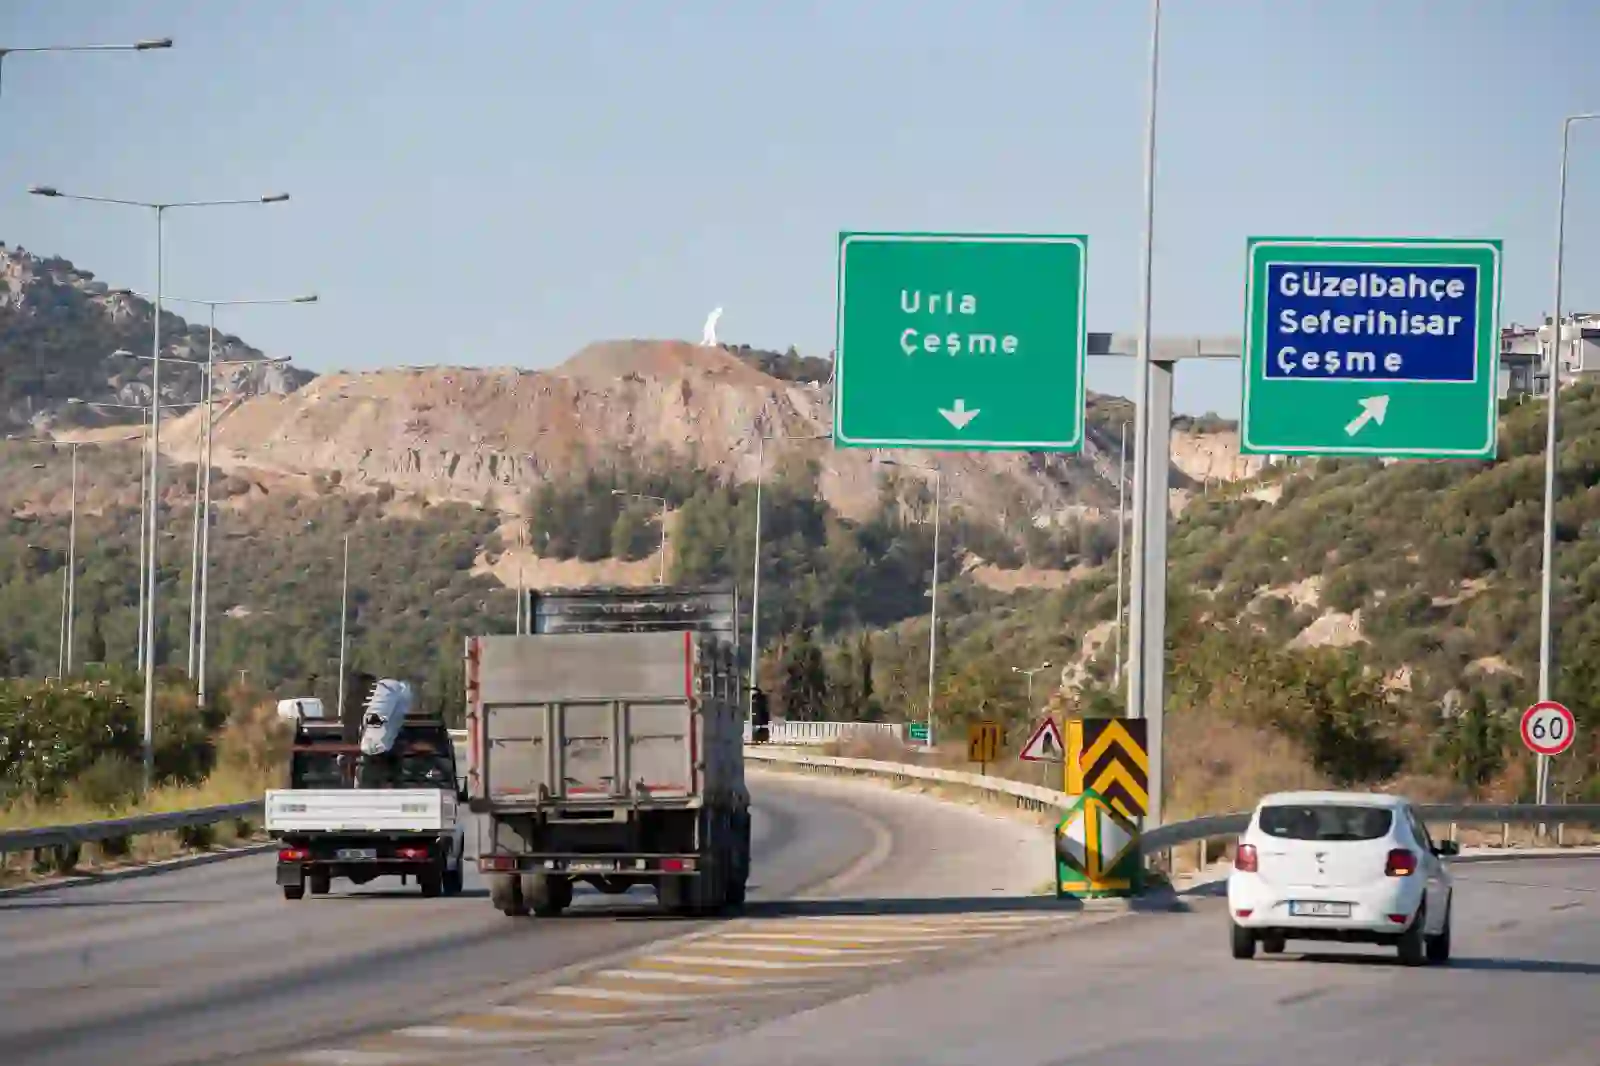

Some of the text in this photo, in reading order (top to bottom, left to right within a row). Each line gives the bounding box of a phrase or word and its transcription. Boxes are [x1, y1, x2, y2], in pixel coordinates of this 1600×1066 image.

[1279, 271, 1465, 301] Güzelbahçe
[901, 289, 976, 315] Urla
[1279, 308, 1462, 336] Seferihisar
[900, 328, 1019, 357] Çeşme
[1277, 345, 1403, 375] Çeşme
[1533, 717, 1563, 740] 60
